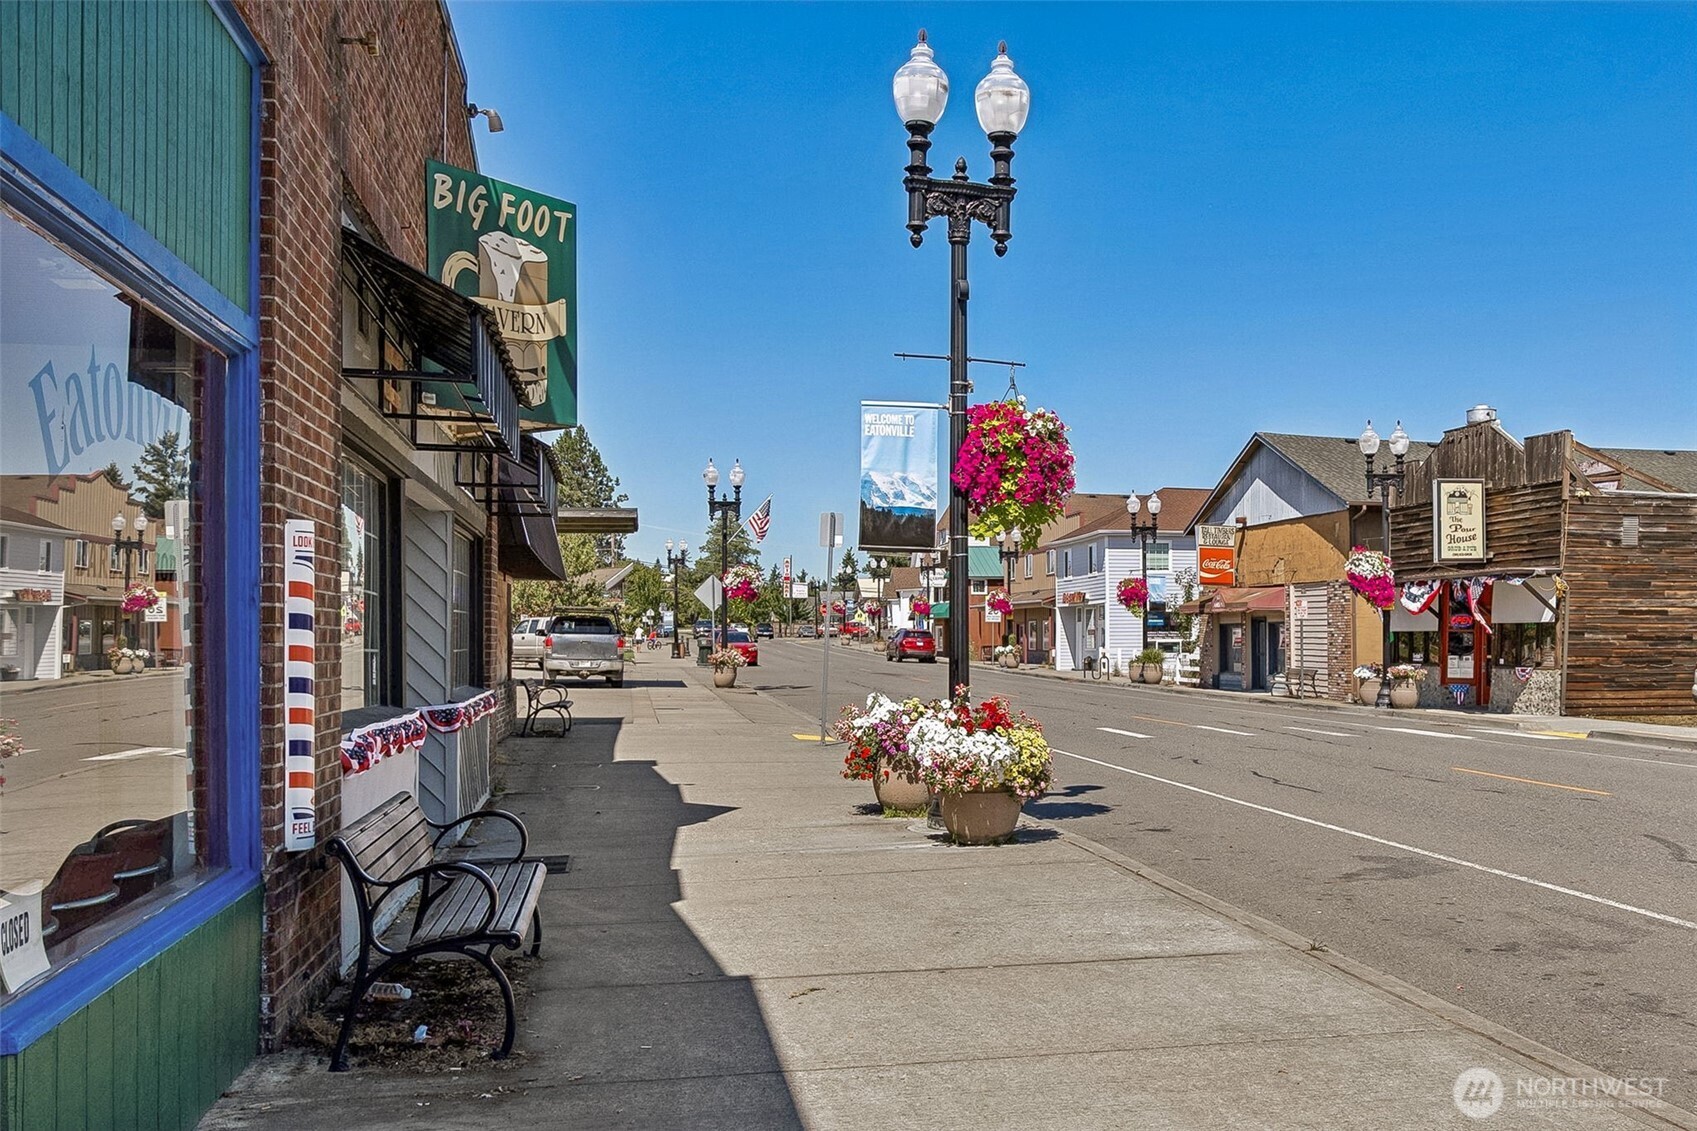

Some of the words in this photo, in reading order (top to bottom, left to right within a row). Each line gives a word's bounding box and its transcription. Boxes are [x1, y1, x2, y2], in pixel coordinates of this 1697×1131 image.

[434, 173, 489, 230] BIG
[498, 193, 572, 243] FOOT
[485, 304, 547, 335] AVERN
[864, 413, 904, 425] WELCOME
[904, 414, 915, 426] TO
[864, 424, 915, 437] EATONVILLE
[1449, 524, 1476, 533] Pour
[293, 535, 313, 548] LOOK
[1445, 533, 1477, 544] House
[292, 822, 312, 835] FEEL
[1, 911, 30, 957] CLOSED
